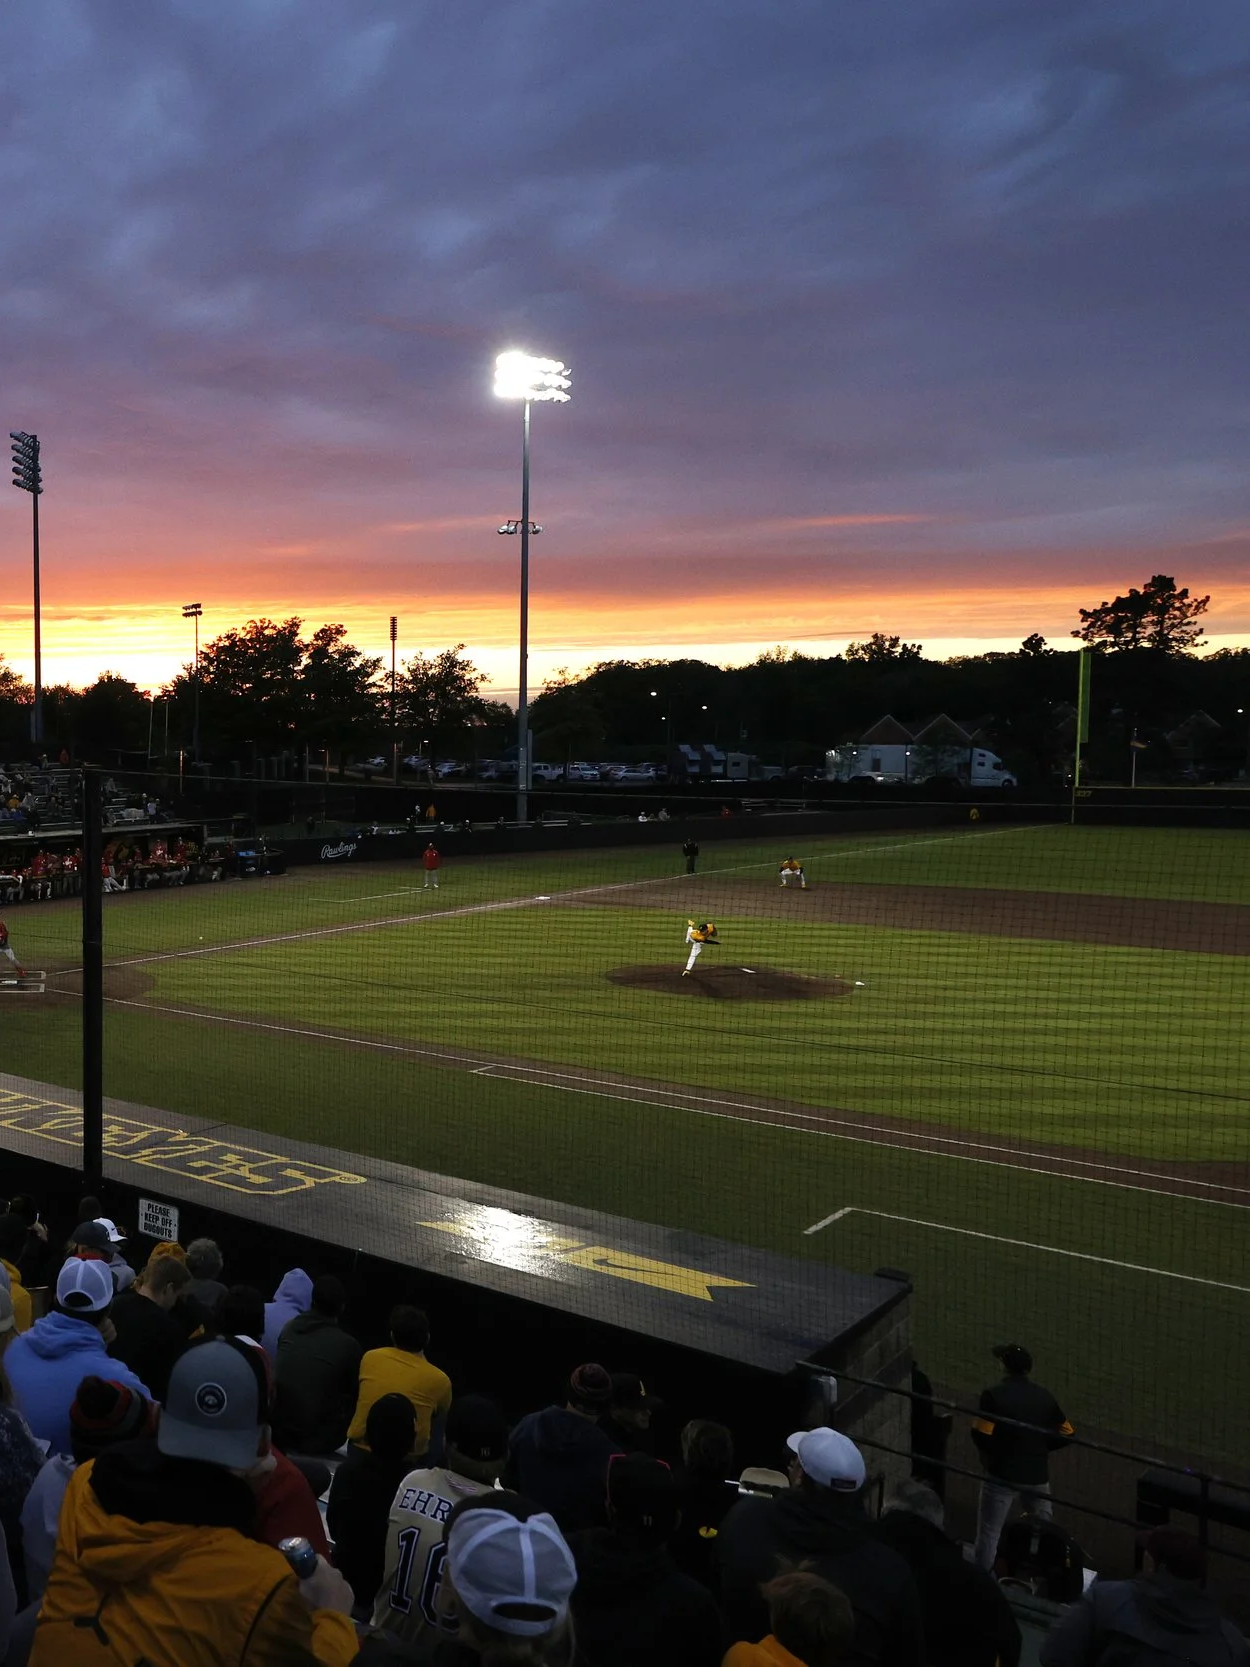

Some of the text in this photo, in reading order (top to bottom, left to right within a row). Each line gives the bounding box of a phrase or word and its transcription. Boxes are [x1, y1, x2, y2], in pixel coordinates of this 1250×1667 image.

[321, 841, 357, 859] Rawlings
[147, 1203, 170, 1217] PLEASE
[144, 1212, 173, 1228] KEEP OFF
[143, 1222, 173, 1239] DUGOUTS
